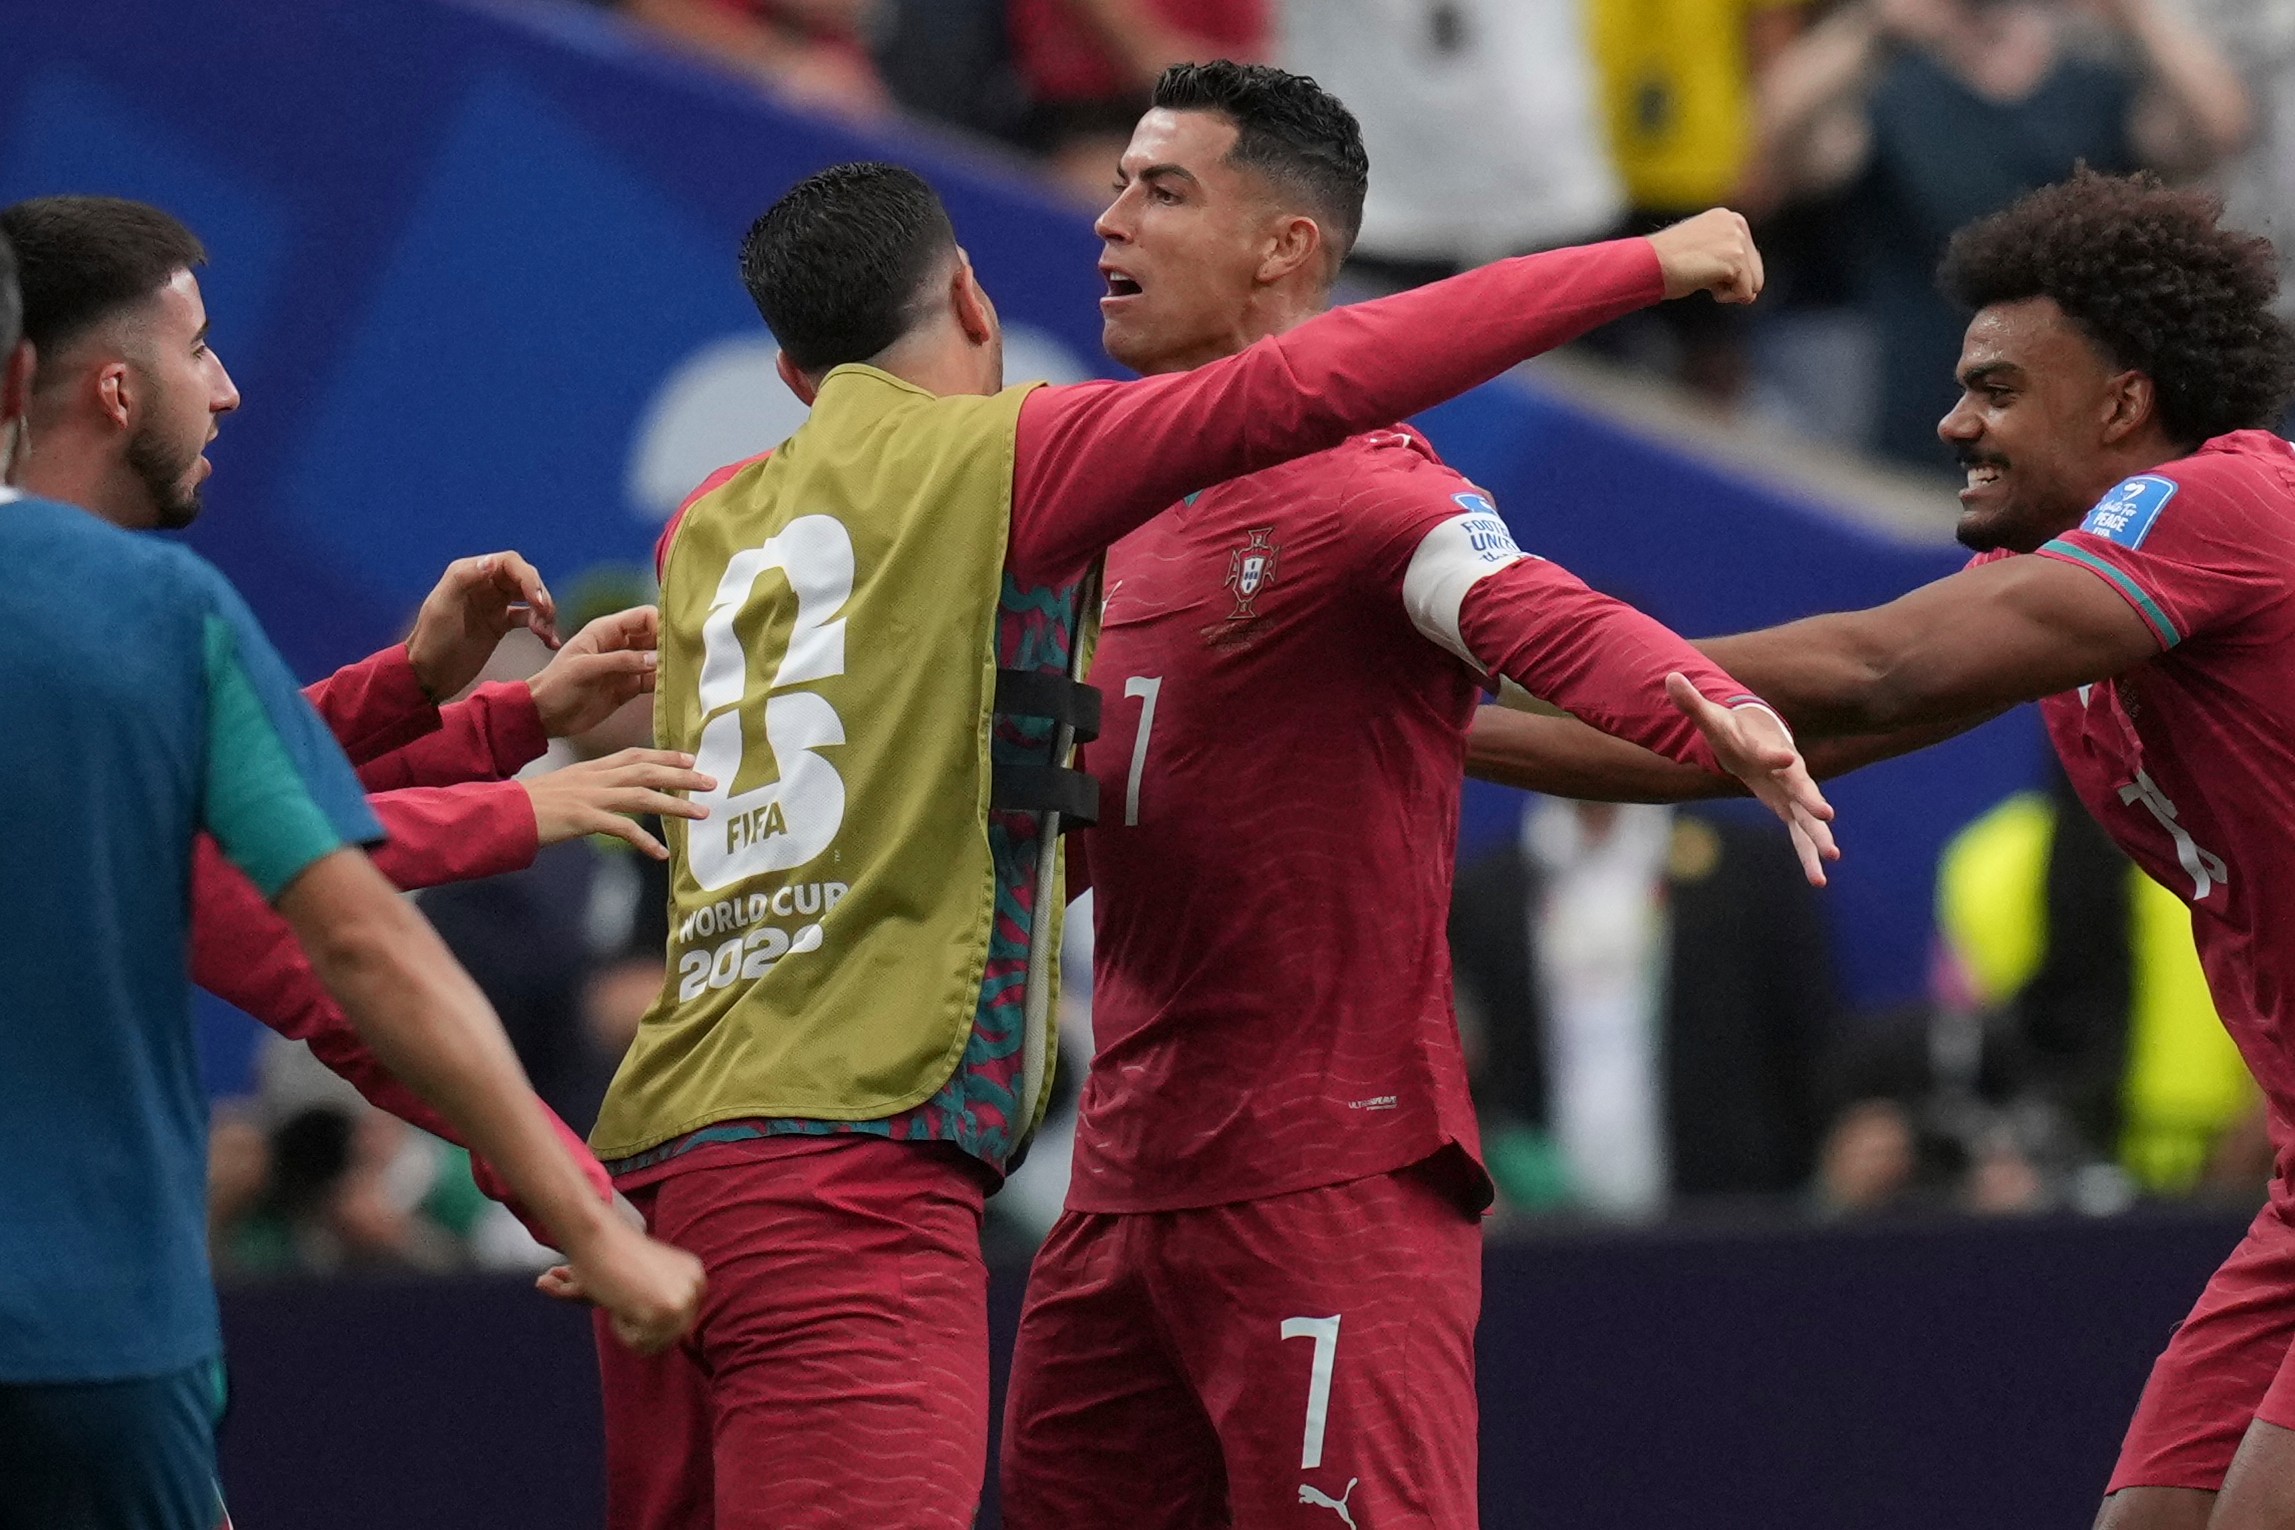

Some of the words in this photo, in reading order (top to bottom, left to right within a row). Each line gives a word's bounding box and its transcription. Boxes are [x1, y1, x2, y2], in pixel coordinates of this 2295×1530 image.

[2092, 511, 2129, 533] PEACE
[1124, 675, 1163, 827] 7
[727, 800, 789, 855] FIFA
[678, 892, 769, 944] WORLD
[771, 881, 849, 917] CUP
[1280, 1313, 1342, 1470] 7
